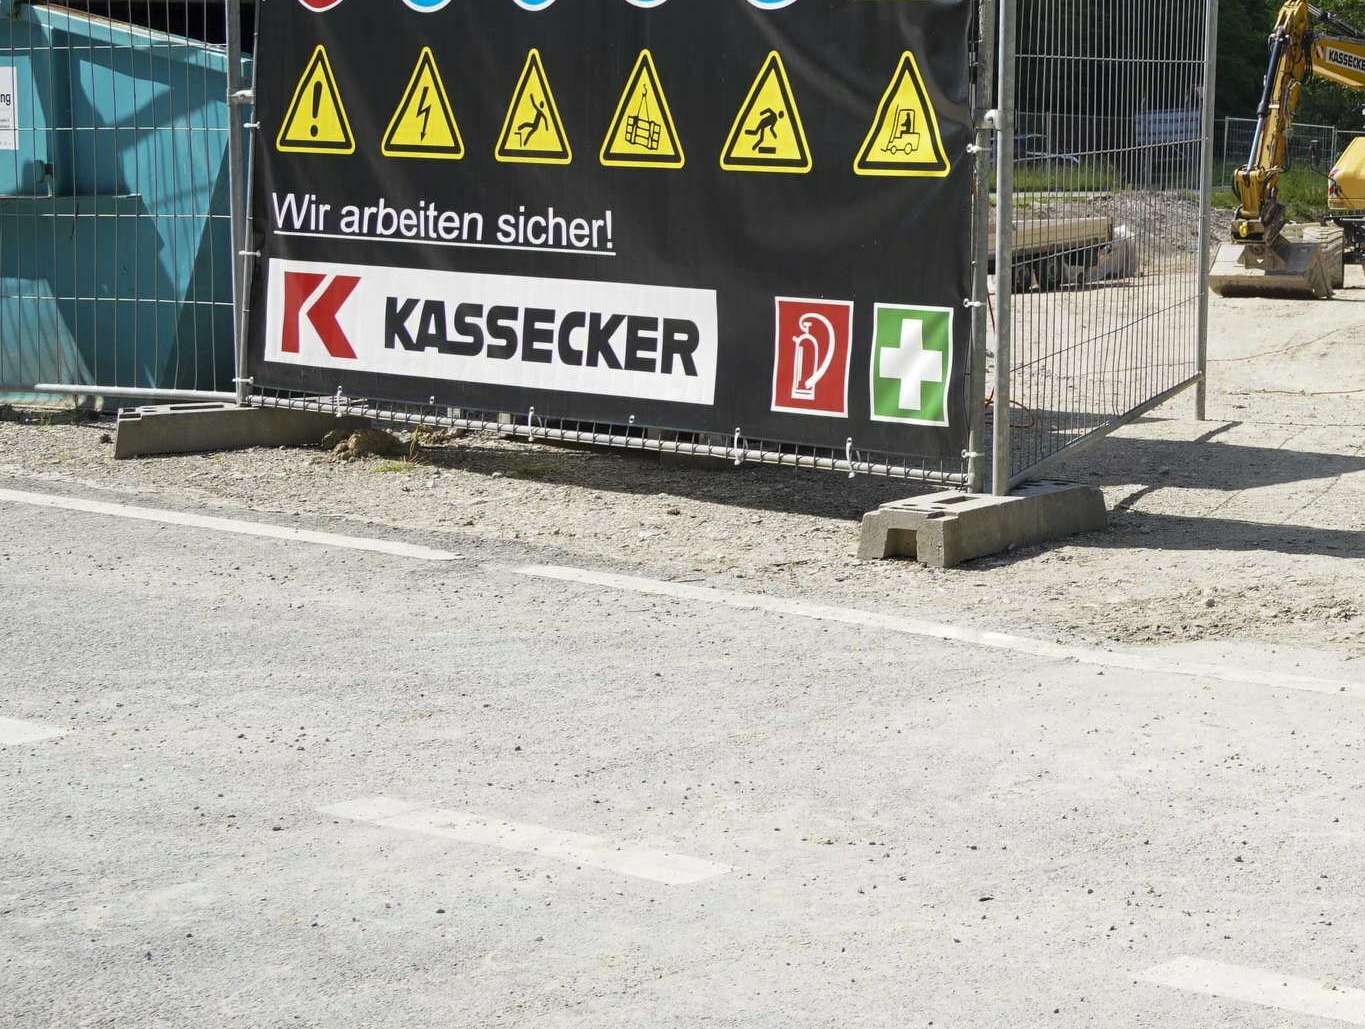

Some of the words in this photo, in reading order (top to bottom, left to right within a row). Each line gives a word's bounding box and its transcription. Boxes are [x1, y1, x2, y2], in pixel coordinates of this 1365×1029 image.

[272, 192, 331, 230] Wir
[339, 198, 483, 241] arbeiten
[496, 205, 614, 249] sicher!
[384, 296, 700, 377] KASSECKER
